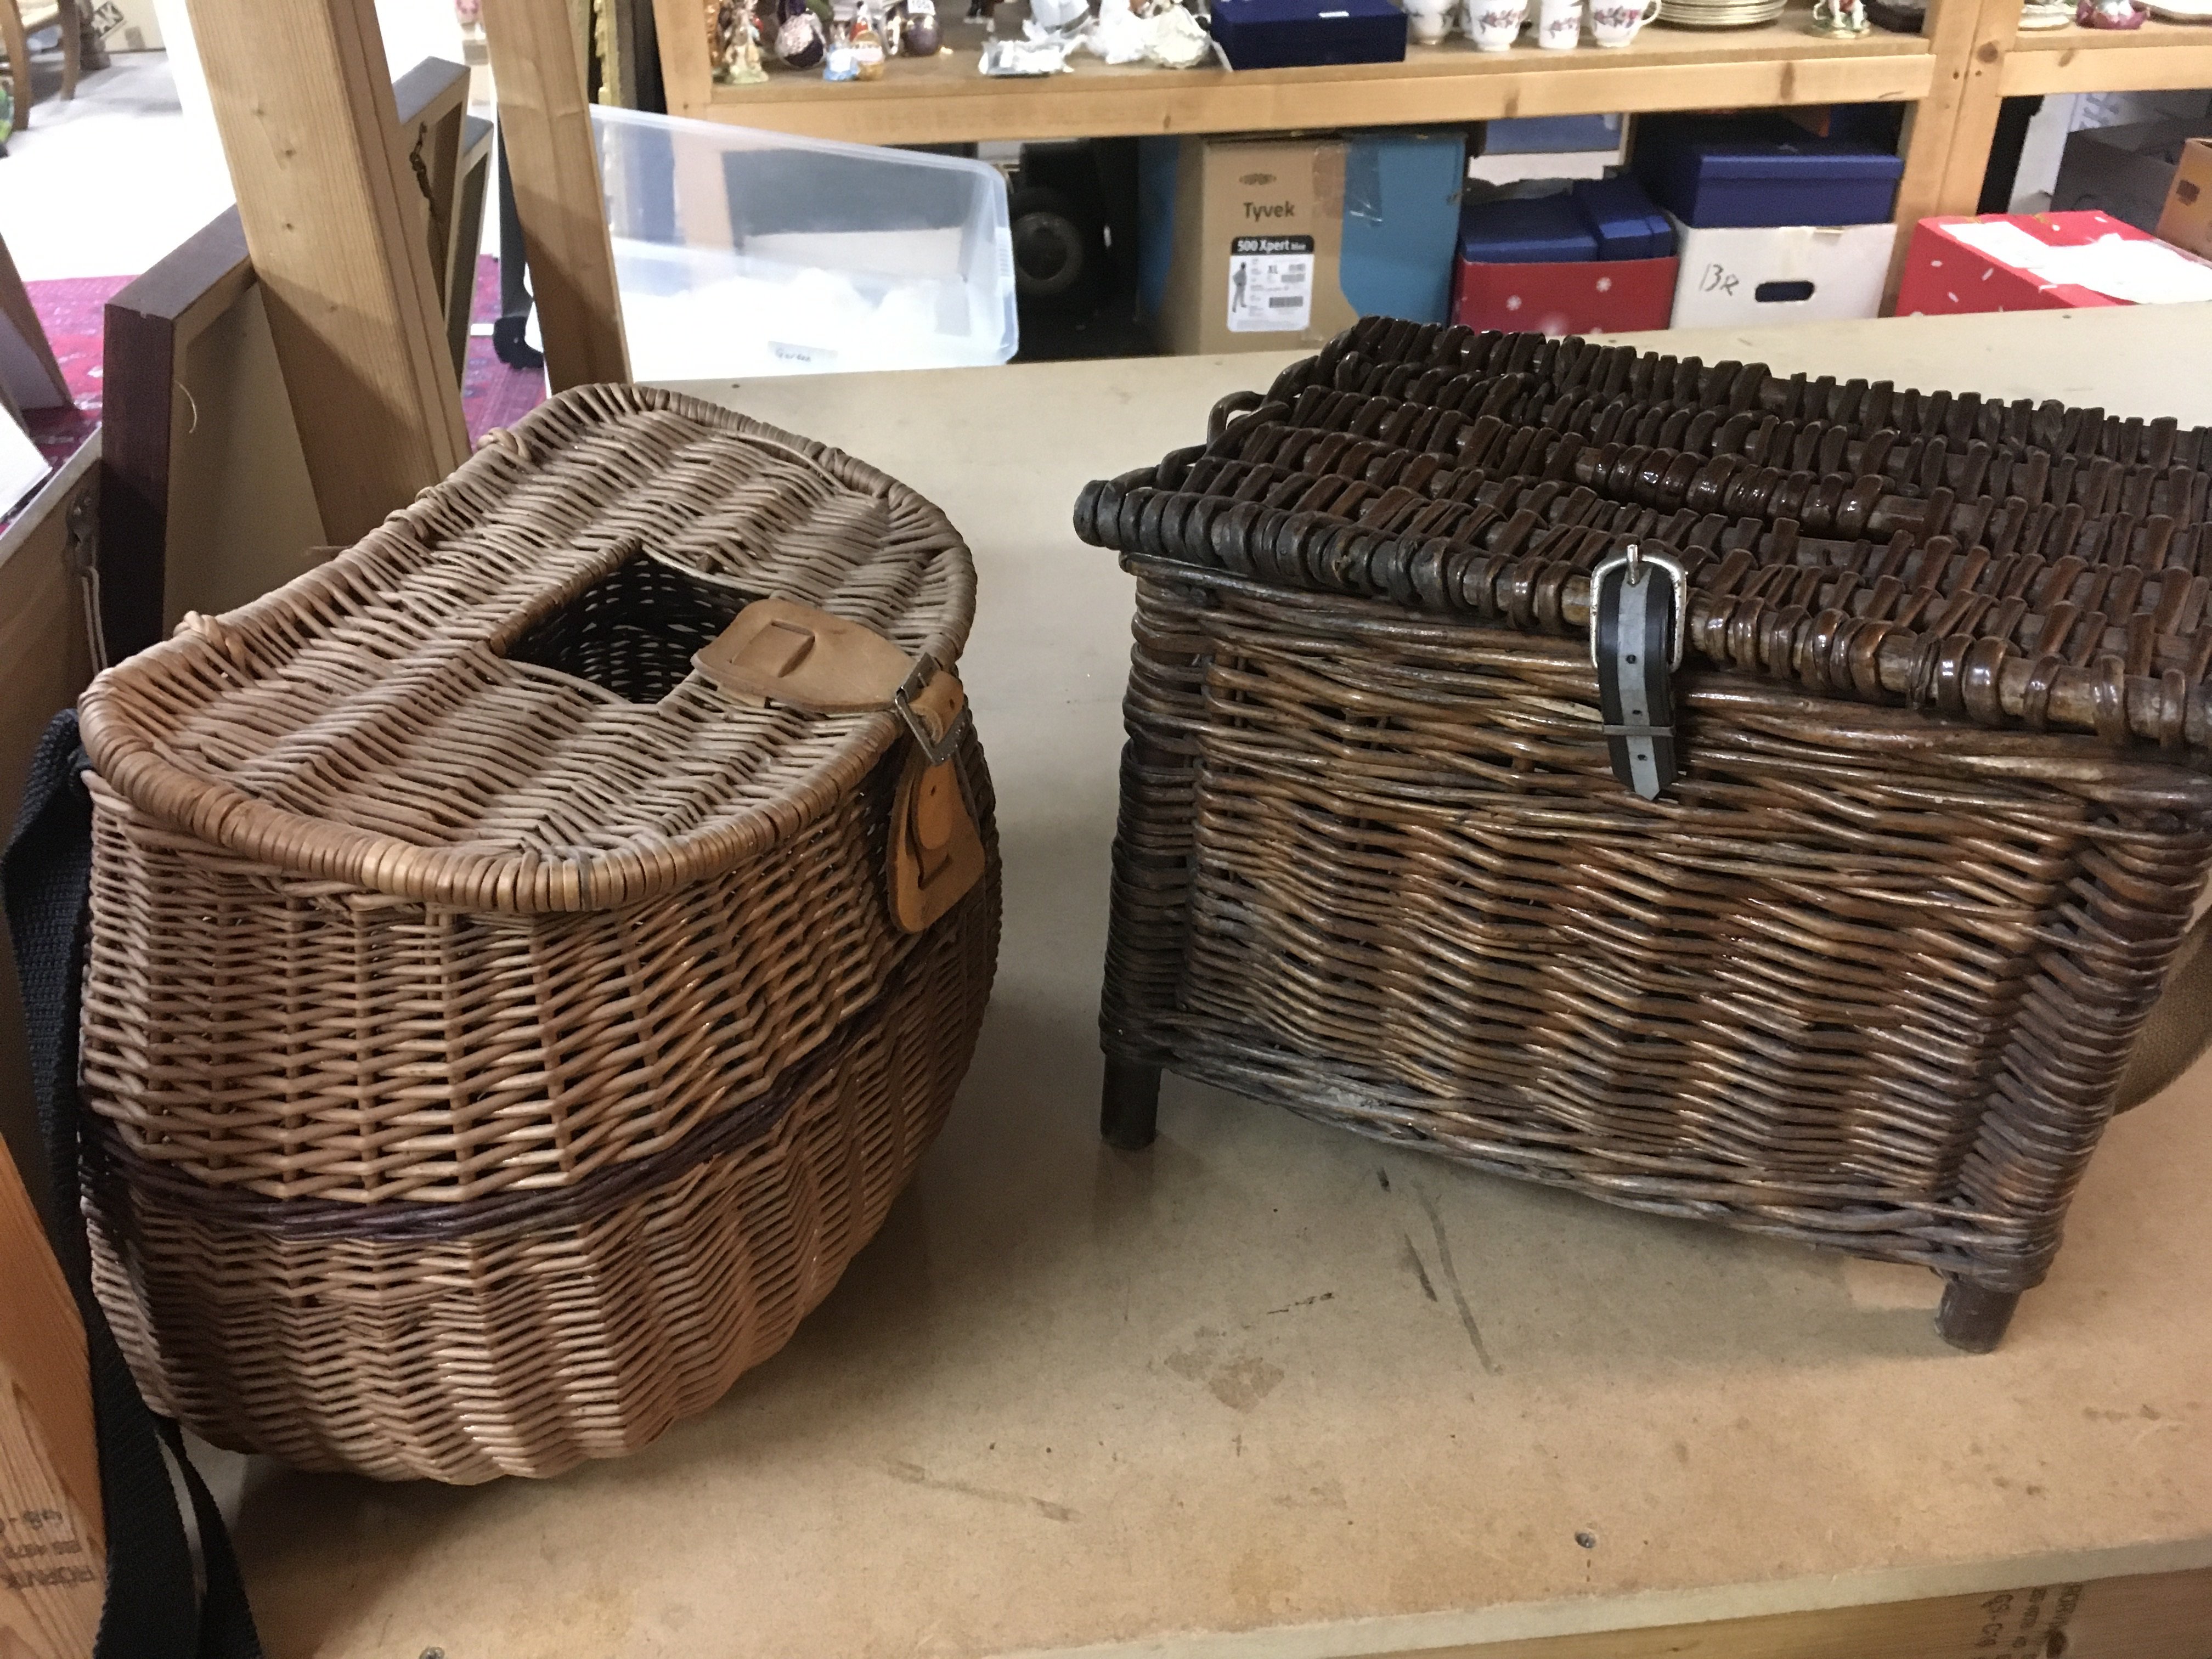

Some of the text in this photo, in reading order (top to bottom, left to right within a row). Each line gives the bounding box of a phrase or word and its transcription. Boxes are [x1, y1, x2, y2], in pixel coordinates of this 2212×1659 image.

[1243, 201, 1295, 222] Tyvek
[1238, 240, 1258, 252] 500
[1259, 239, 1289, 254] Xpert
